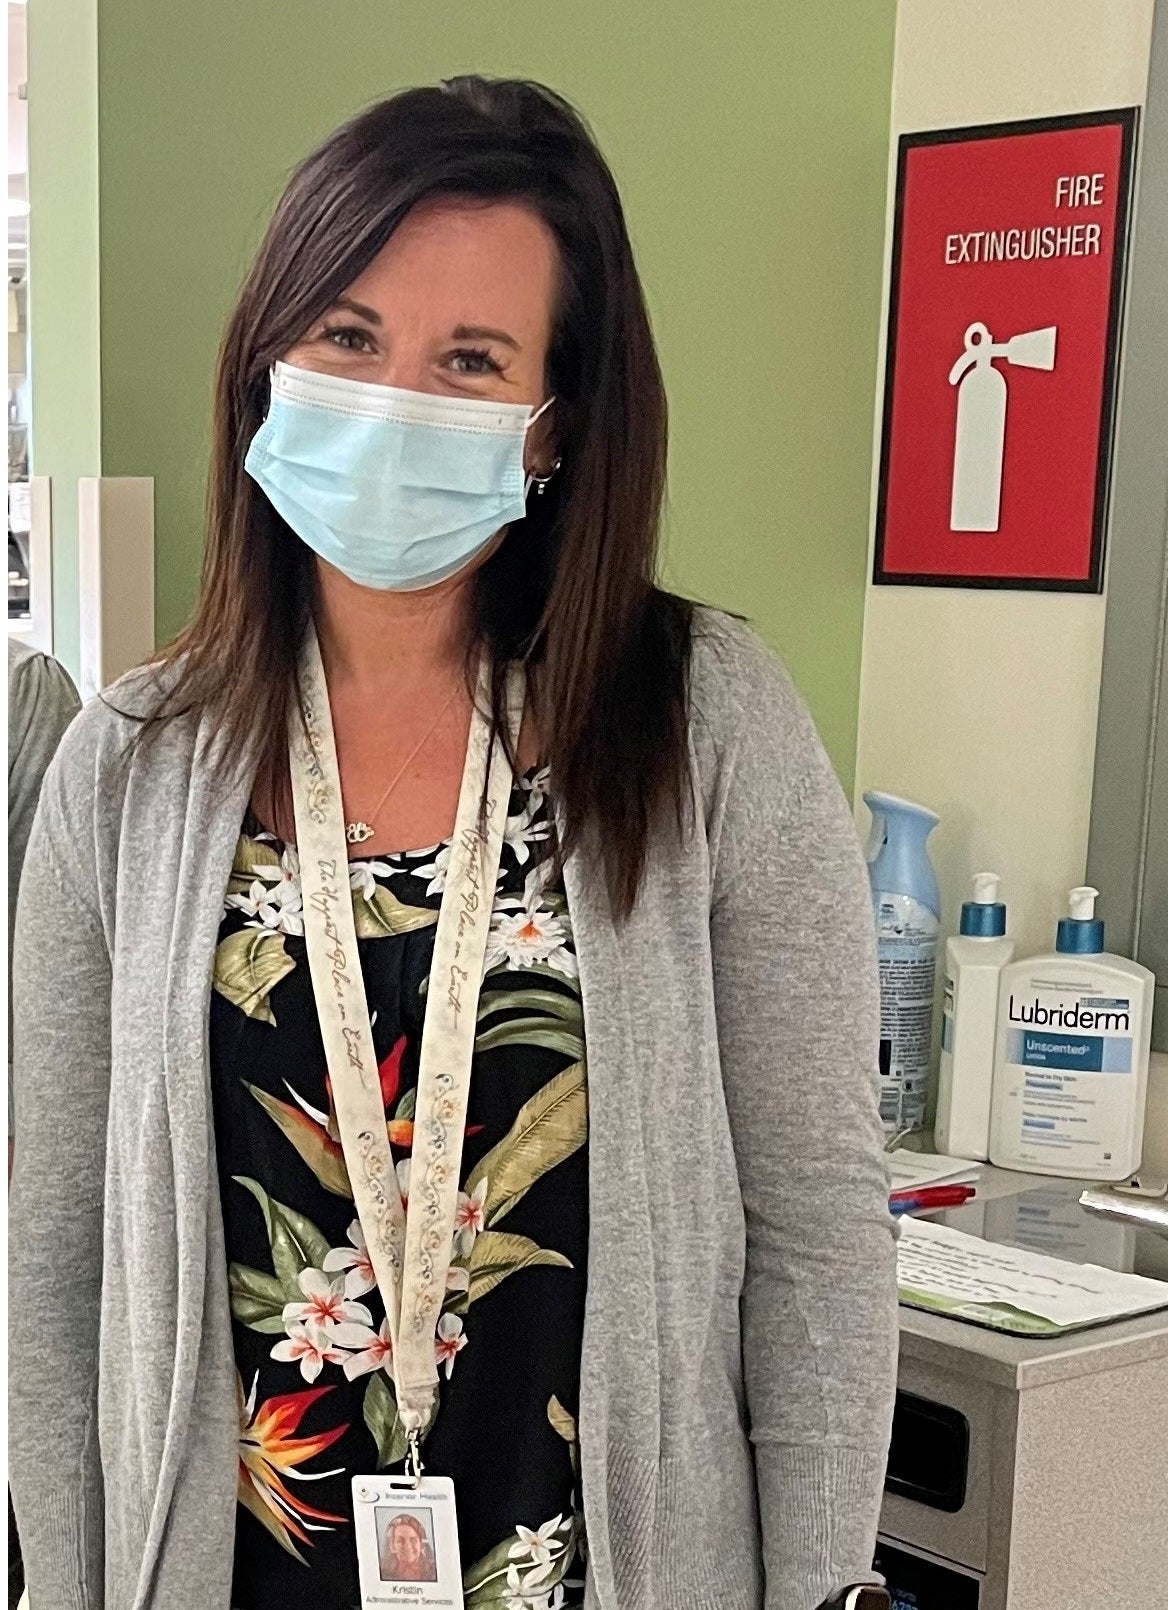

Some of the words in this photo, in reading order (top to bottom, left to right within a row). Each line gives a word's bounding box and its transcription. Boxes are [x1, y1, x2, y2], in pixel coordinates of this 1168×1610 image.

[1055, 173, 1105, 208] FIRE
[945, 223, 1101, 265] EXTINGUISHER
[317, 858, 338, 883] The
[311, 886, 342, 945] Happiest
[459, 892, 480, 938] Place
[453, 941, 462, 959] on
[326, 947, 351, 999] Place
[337, 1003, 347, 1021] on
[447, 965, 469, 1030] Earth
[1009, 995, 1129, 1031] Lubriderm
[341, 1027, 367, 1091] Earth
[392, 1585, 424, 1595] Kristin
